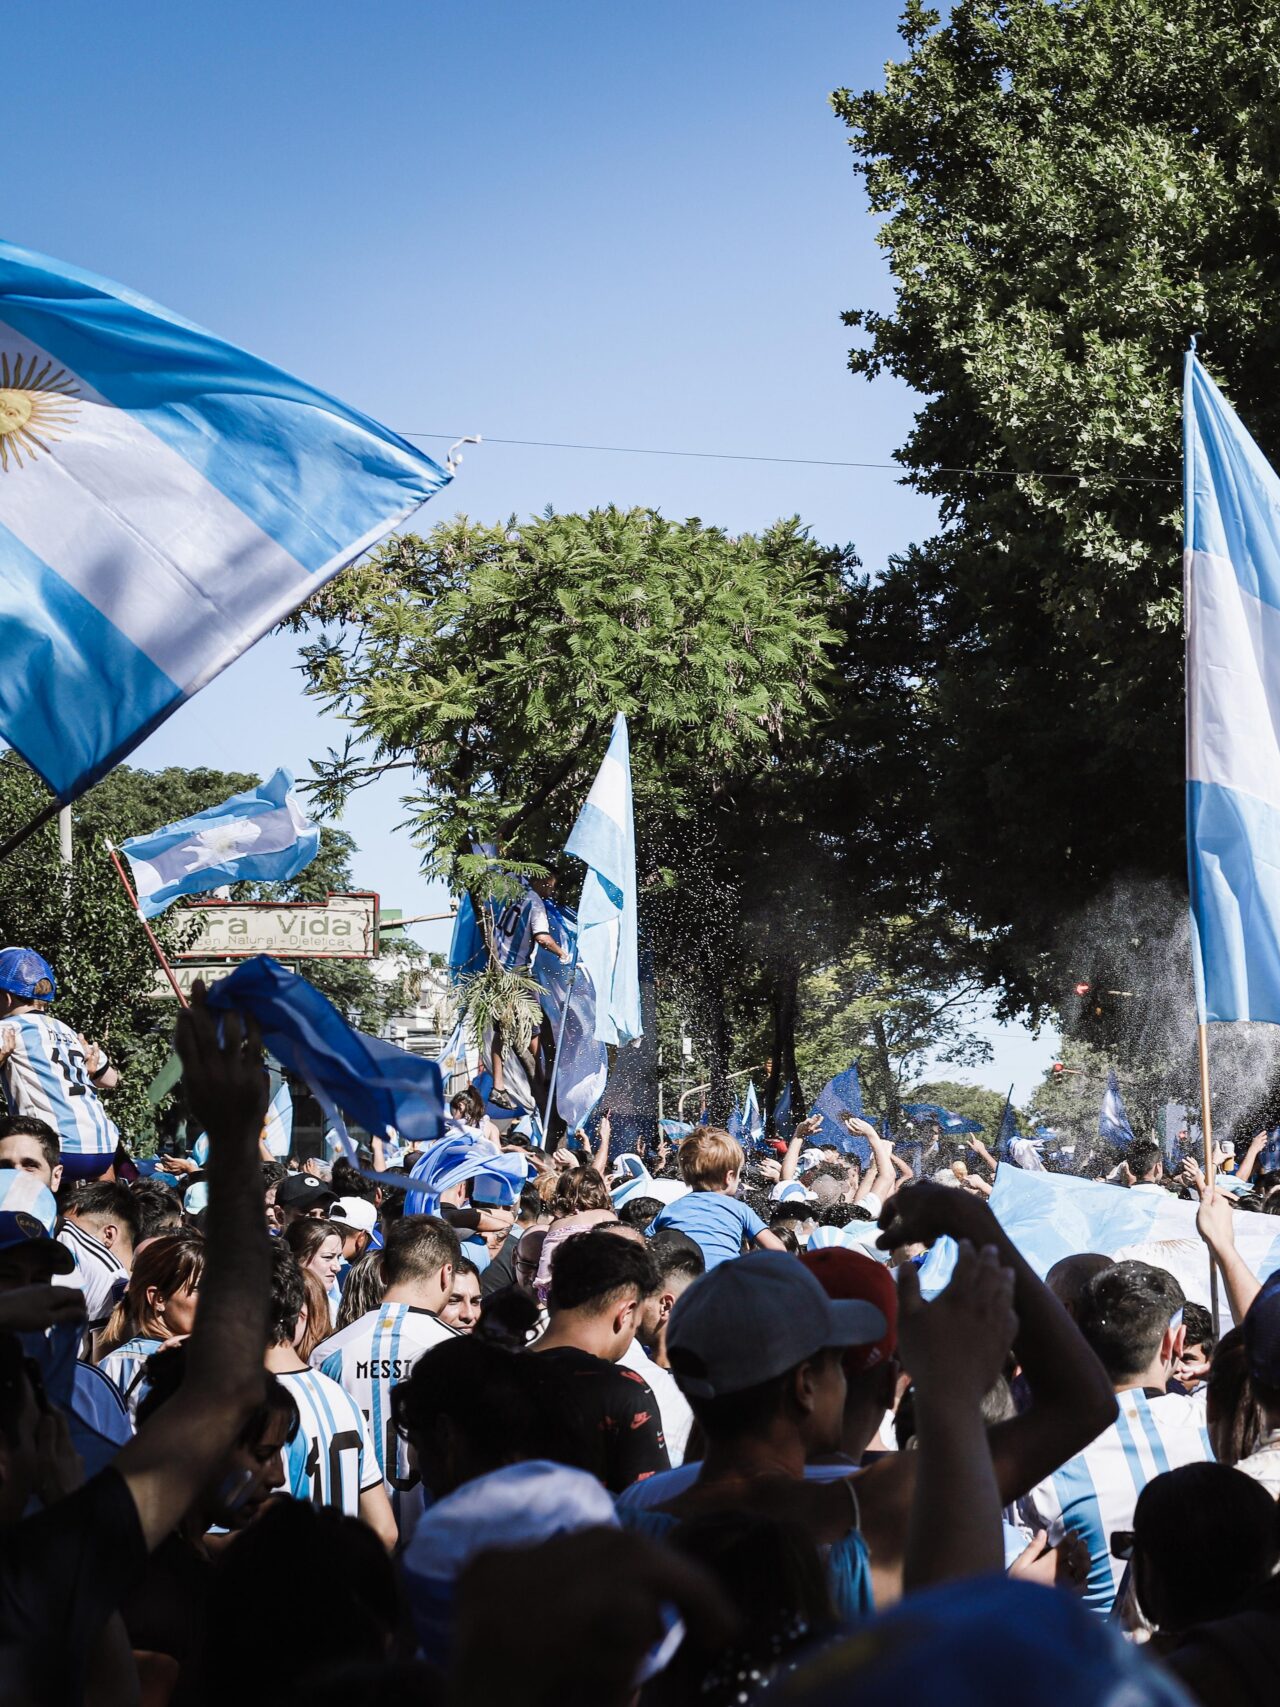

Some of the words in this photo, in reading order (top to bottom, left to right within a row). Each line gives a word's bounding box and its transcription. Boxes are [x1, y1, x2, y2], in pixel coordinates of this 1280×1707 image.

[276, 914, 351, 936] Vida
[228, 935, 277, 945] Natural
[51, 1047, 98, 1100] 10
[356, 1360, 412, 1379] MESSI
[305, 1430, 363, 1511] 10
